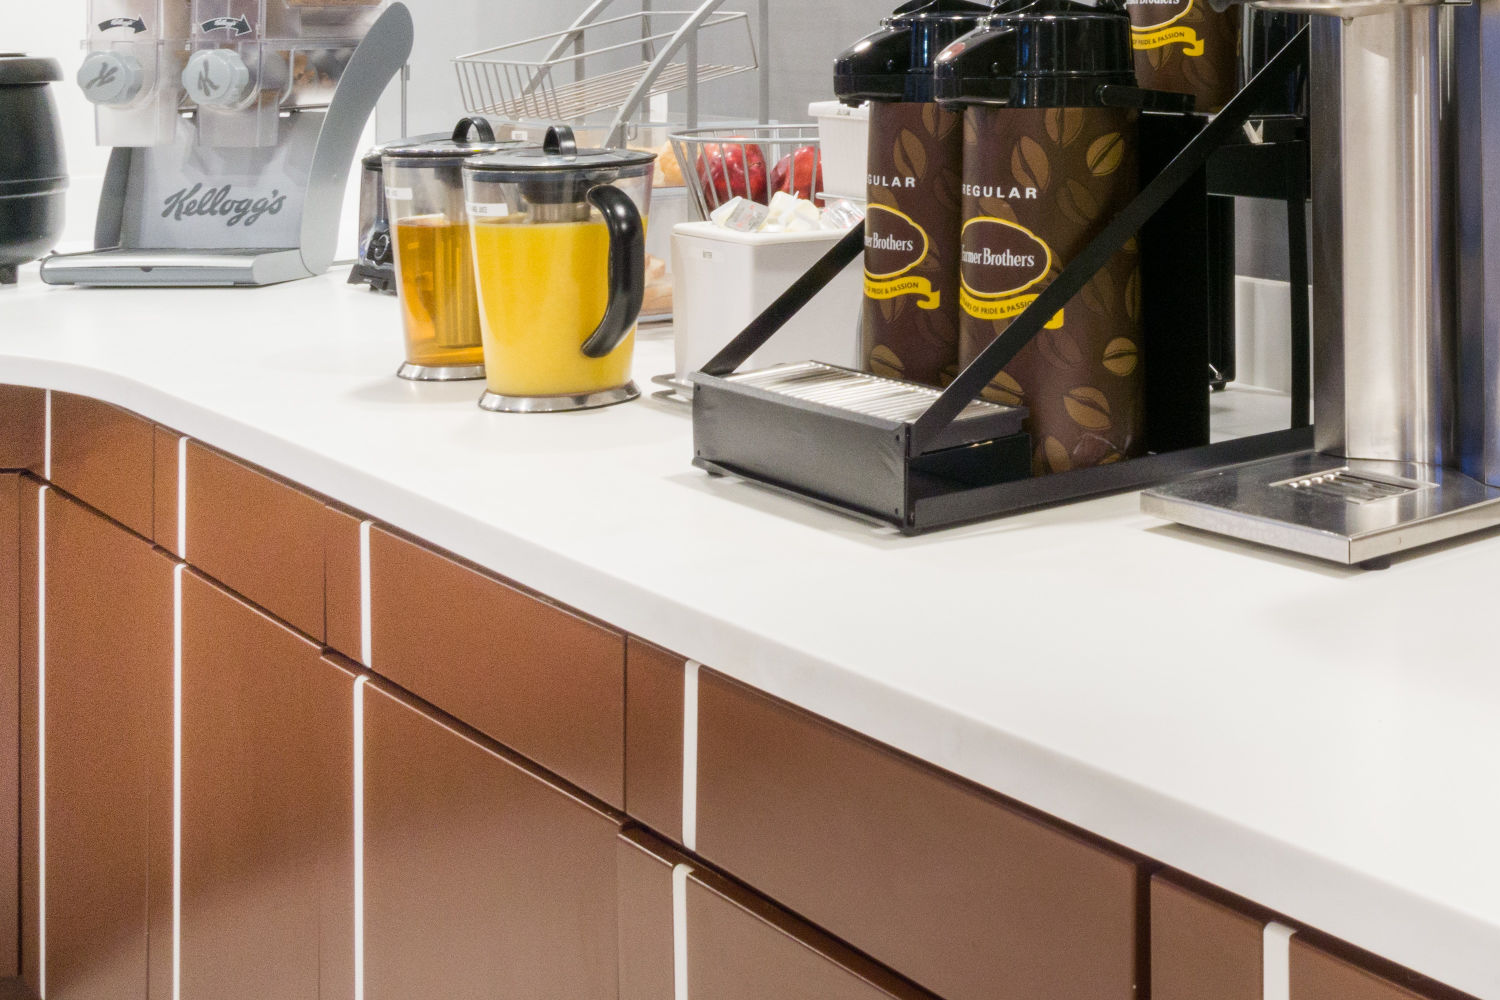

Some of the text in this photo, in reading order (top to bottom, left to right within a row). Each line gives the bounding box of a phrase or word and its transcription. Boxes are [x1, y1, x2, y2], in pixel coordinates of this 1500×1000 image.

[867, 174, 916, 188] GULAR
[962, 183, 1037, 199] REGULAR
[161, 182, 287, 227] Kellogg's
[873, 232, 914, 251] Brothers
[983, 247, 1035, 267] Brothers
[890, 282, 919, 293] PASSION
[1007, 300, 1034, 313] PASSIO
